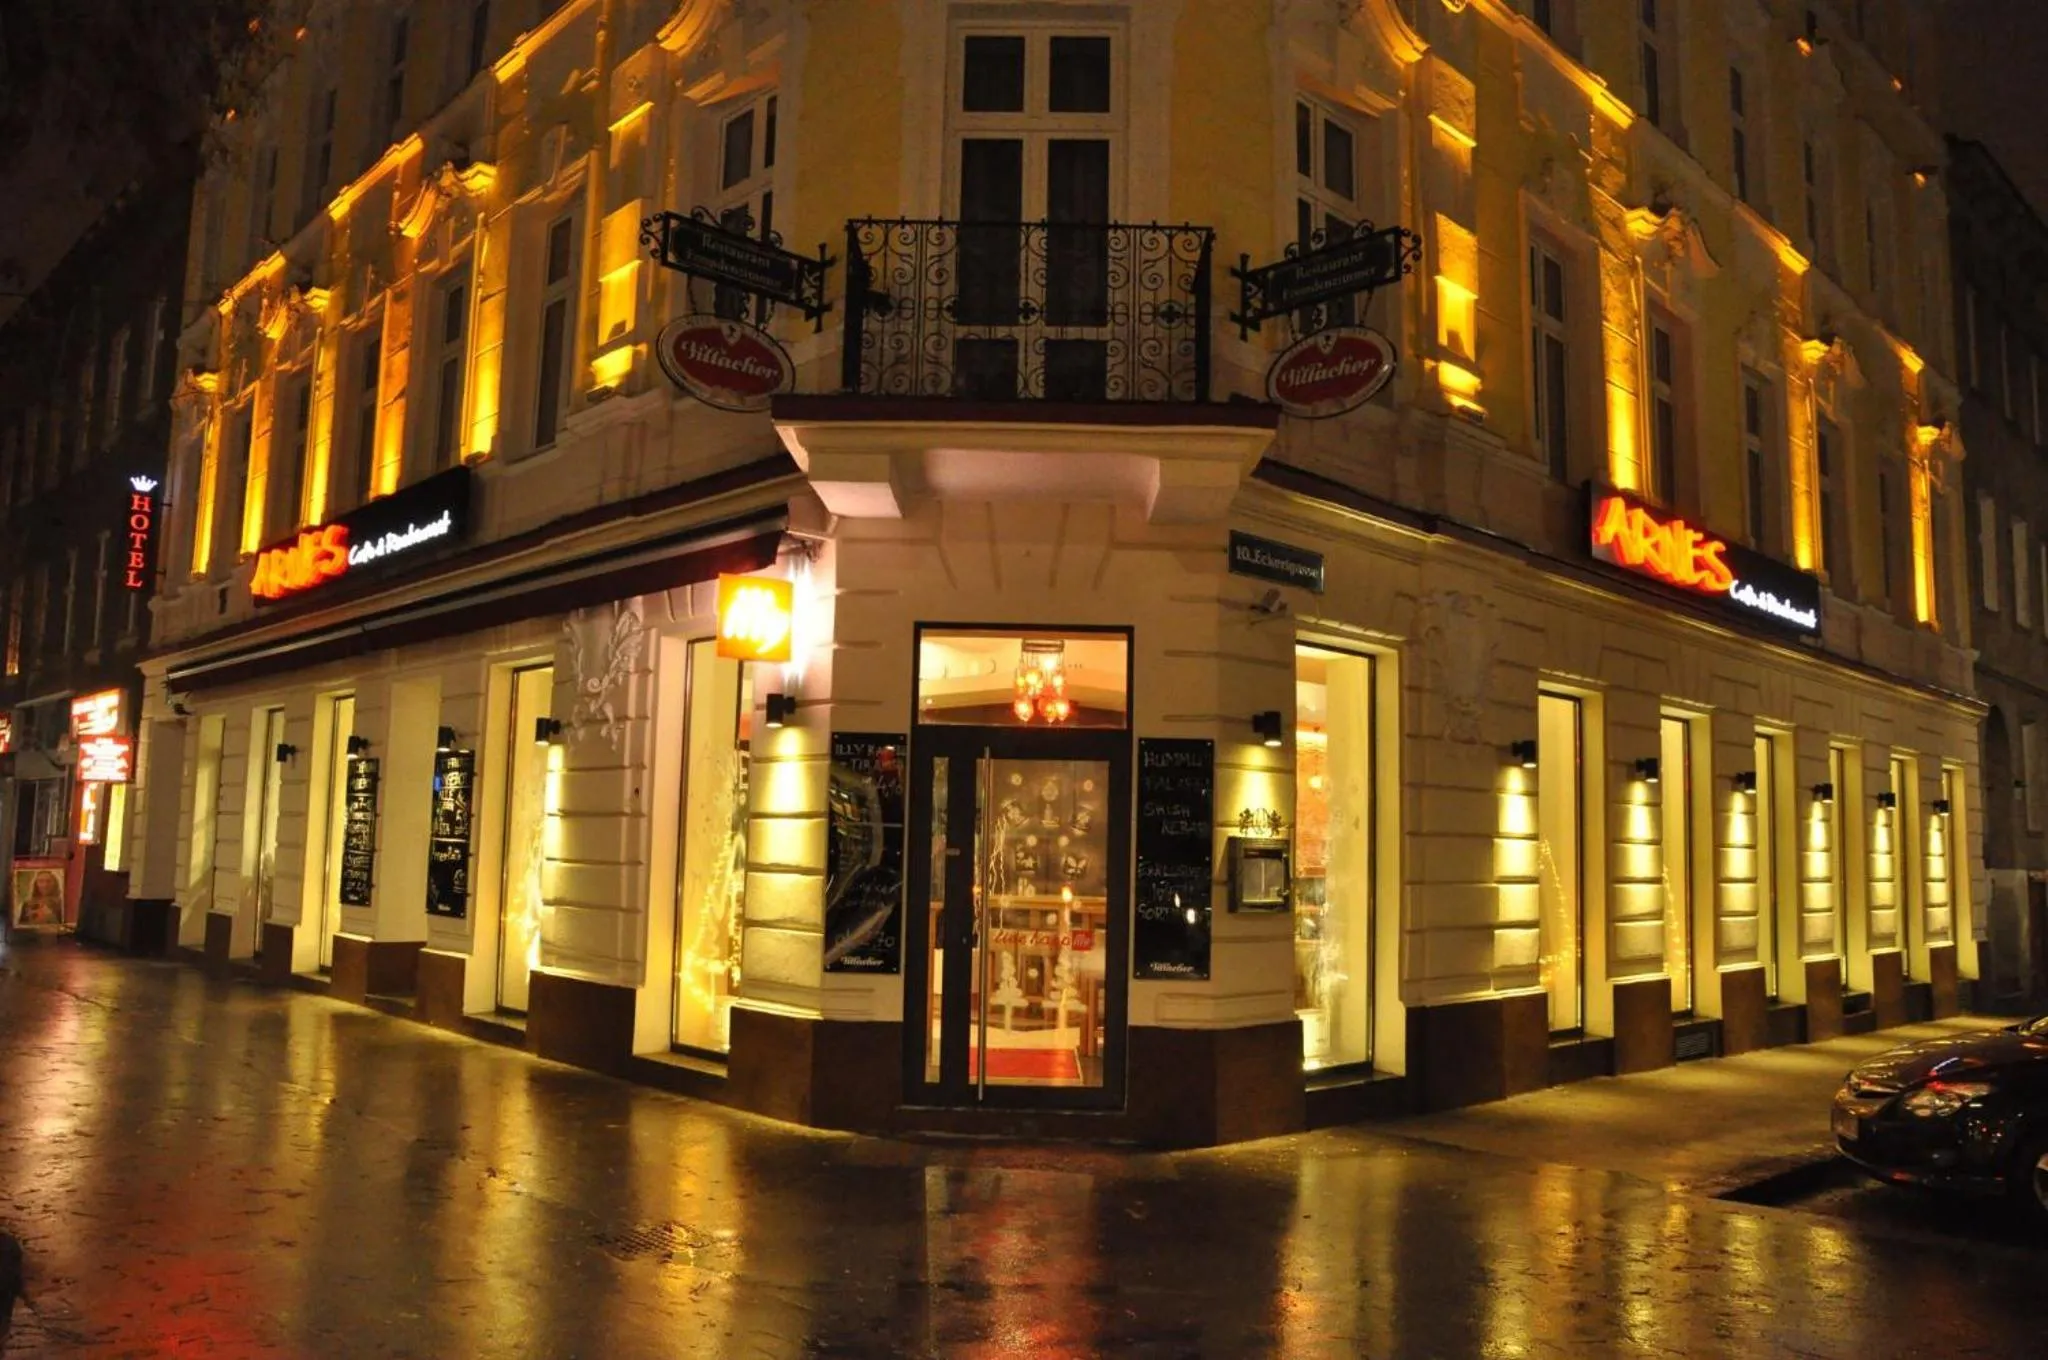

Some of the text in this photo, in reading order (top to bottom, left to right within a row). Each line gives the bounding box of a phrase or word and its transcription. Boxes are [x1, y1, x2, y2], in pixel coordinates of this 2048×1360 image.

[681, 339, 778, 379] Villacher
[1281, 355, 1377, 388] Villacher
[126, 493, 153, 588] HOTEL
